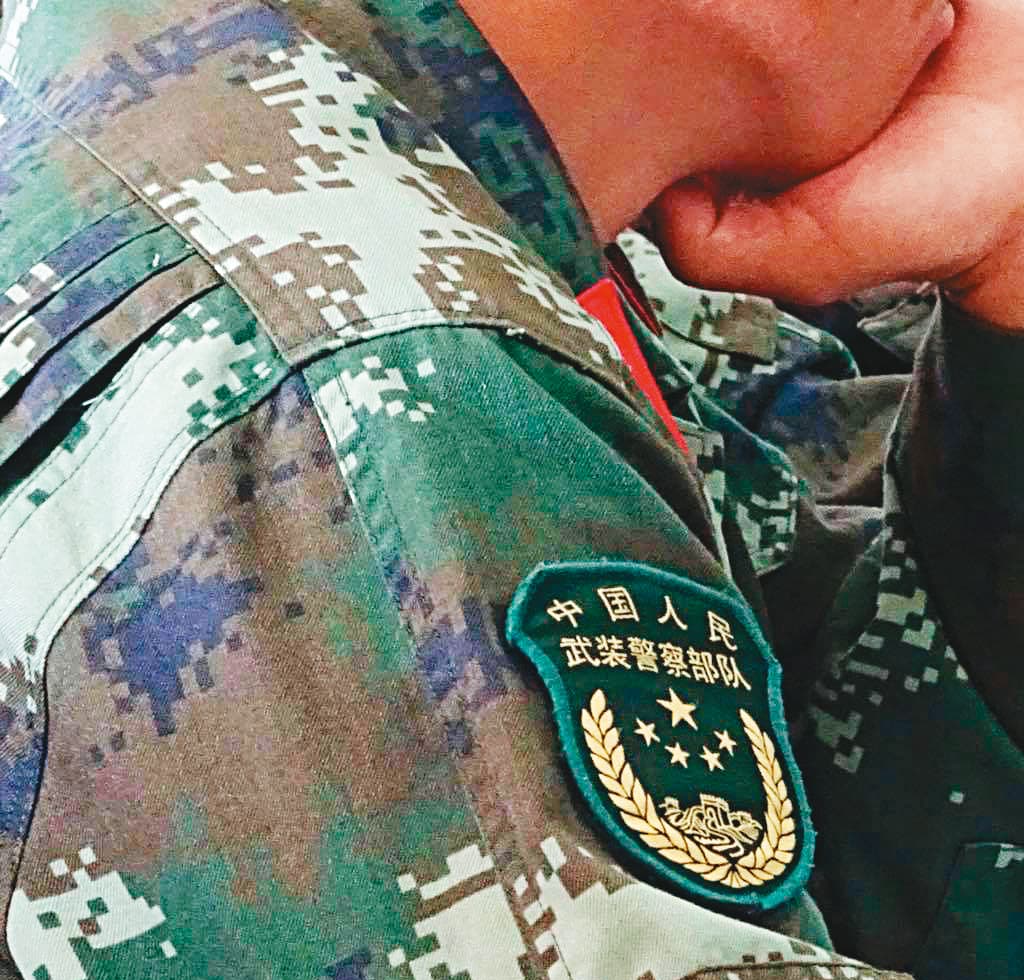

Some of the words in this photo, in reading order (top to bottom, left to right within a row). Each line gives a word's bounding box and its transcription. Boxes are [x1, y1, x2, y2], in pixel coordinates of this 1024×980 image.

[546, 585, 738, 650] 中国人民
[559, 634, 753, 691] 武装警察部队
